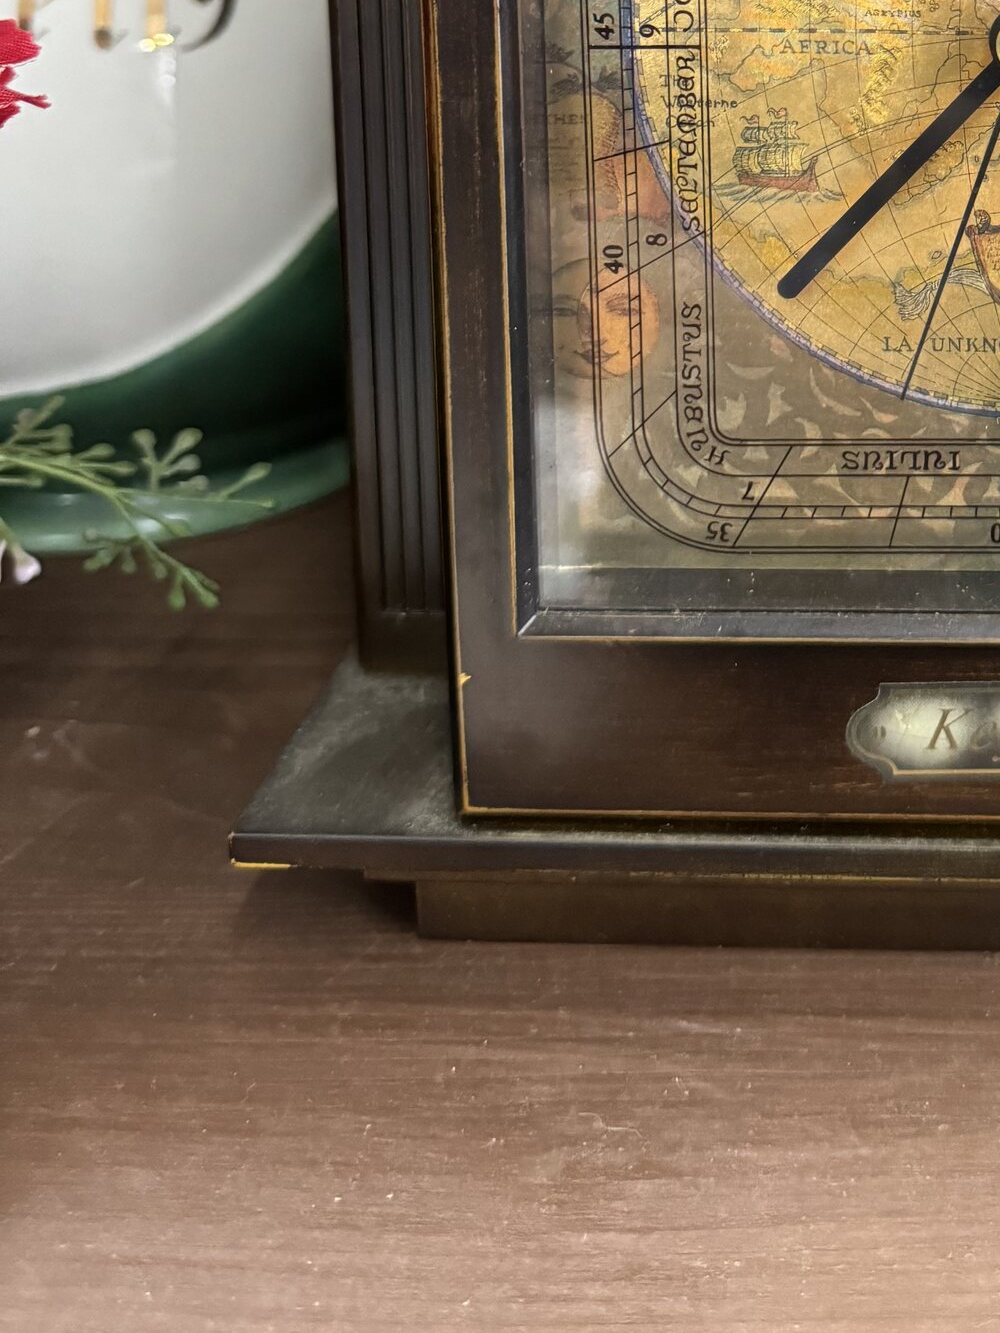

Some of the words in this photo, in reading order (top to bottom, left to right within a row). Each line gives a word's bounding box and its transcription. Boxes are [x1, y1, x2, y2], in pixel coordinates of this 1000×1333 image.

[594, 13, 615, 41] 45
[639, 24, 662, 38] 9
[779, 39, 874, 56] AFRICA
[645, 233, 668, 247] 8
[602, 244, 624, 275] 40
[741, 481, 755, 500] 7
[705, 520, 734, 542] 35
